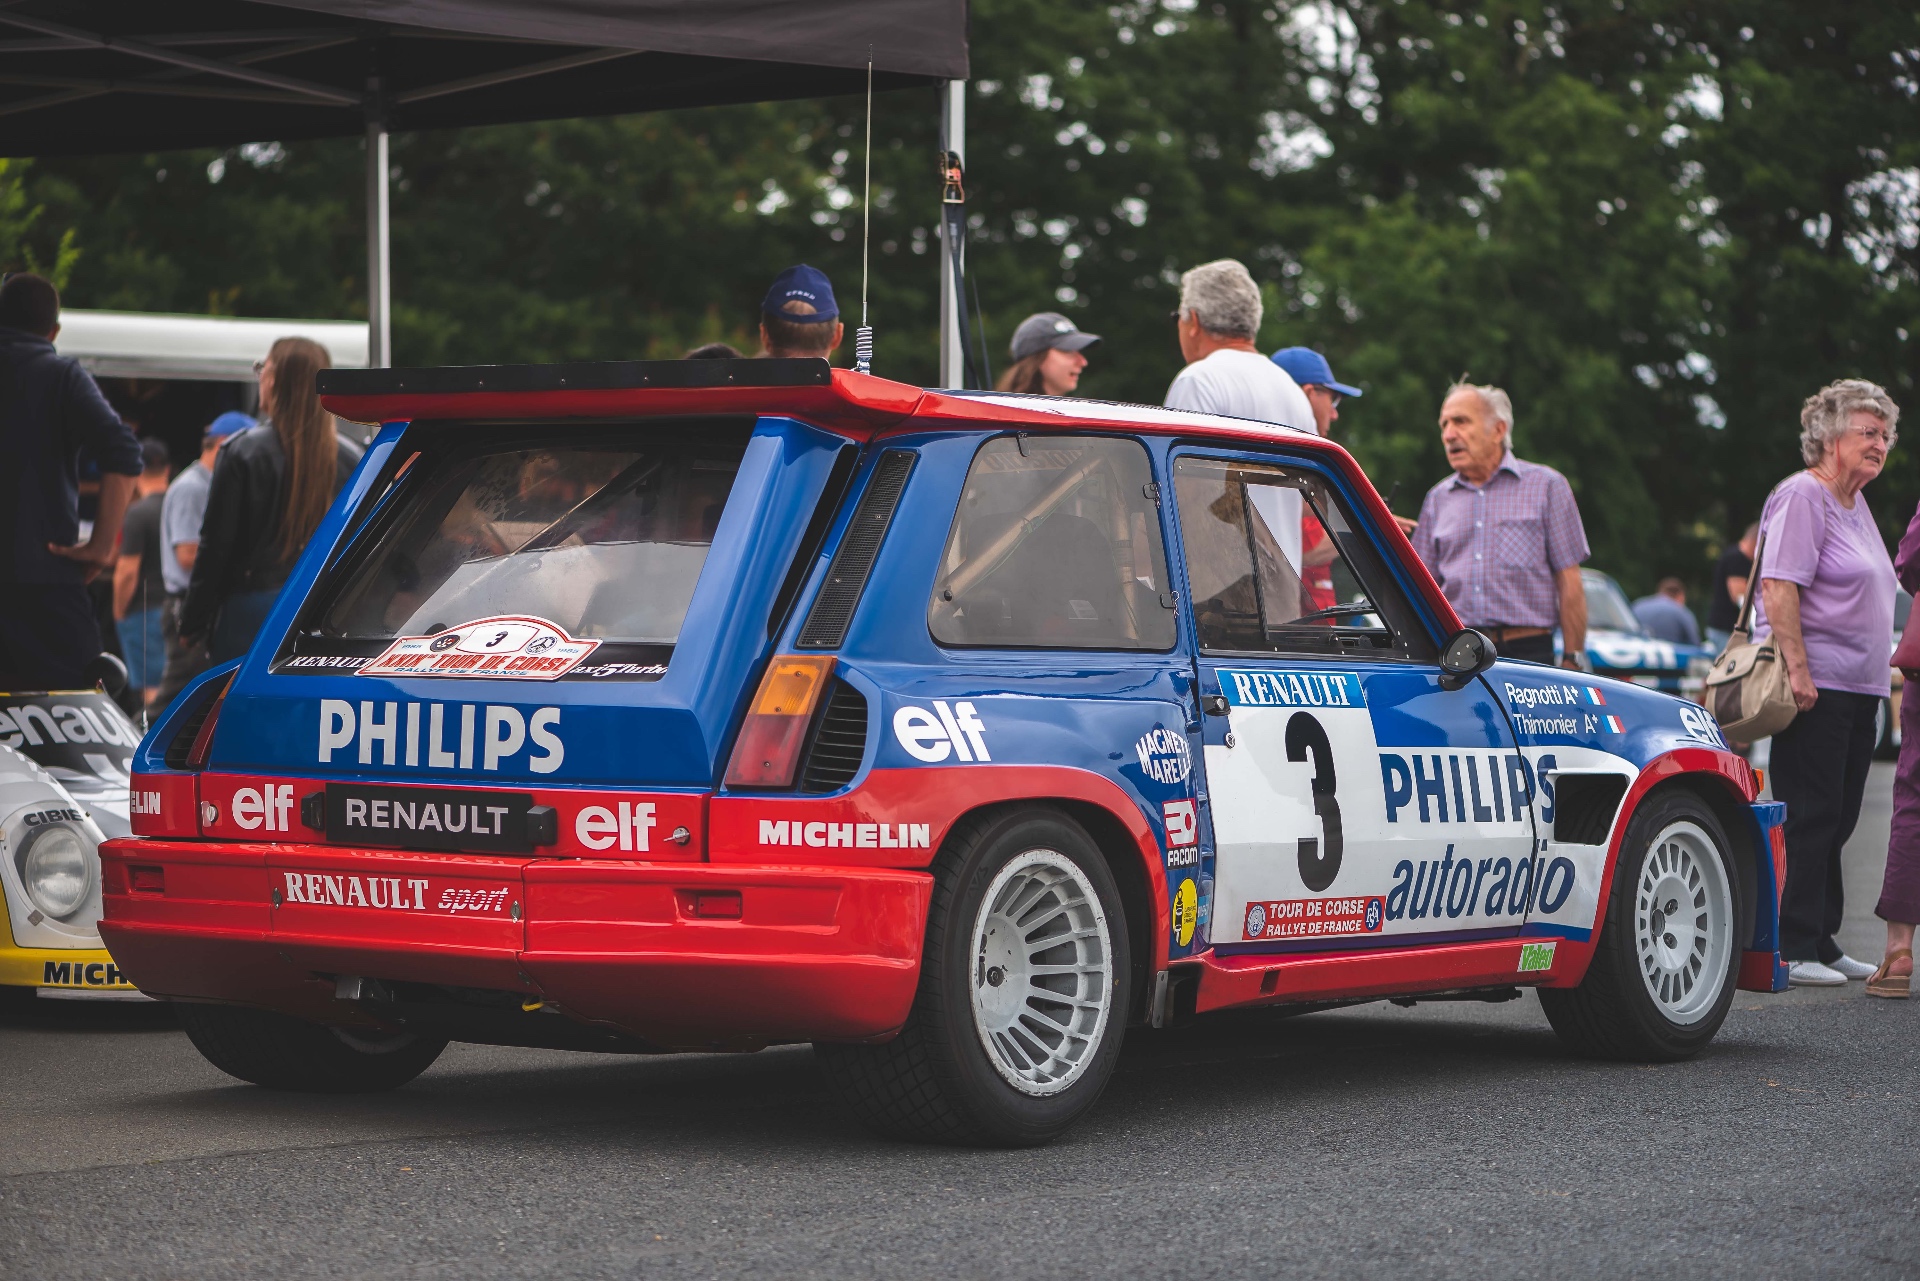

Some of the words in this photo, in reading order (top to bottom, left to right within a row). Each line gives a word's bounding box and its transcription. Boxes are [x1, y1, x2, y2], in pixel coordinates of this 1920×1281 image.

[485, 631, 508, 648] 3
[431, 653, 481, 669] TOUR
[478, 655, 511, 670] DE
[504, 656, 573, 671] CORSE
[1231, 672, 1350, 706] RENAULT
[1504, 682, 1564, 709] Ragnotti
[318, 699, 565, 774] PHILIPS
[893, 700, 991, 763] elf
[1512, 713, 1578, 735] Thimonier
[1679, 707, 1729, 750] elf
[1284, 710, 1344, 892] 3
[1379, 754, 1557, 823] PHILIPS
[232, 783, 294, 832] elf
[346, 798, 509, 835] RENAULT
[575, 801, 657, 852] elf
[758, 819, 930, 849] MICHELIN
[1167, 846, 1198, 867] FACOM
[284, 872, 429, 910] RENAULT
[438, 886, 509, 914] sport
[1385, 839, 1576, 921] autoradio
[1269, 902, 1304, 919] TOUR
[1306, 901, 1323, 917] DE
[1325, 899, 1365, 915] CORSE
[1265, 922, 1306, 937] RALLYE
[1307, 921, 1322, 934] DE
[1322, 919, 1363, 933] FRANCE
[1521, 944, 1554, 971] Valeo
